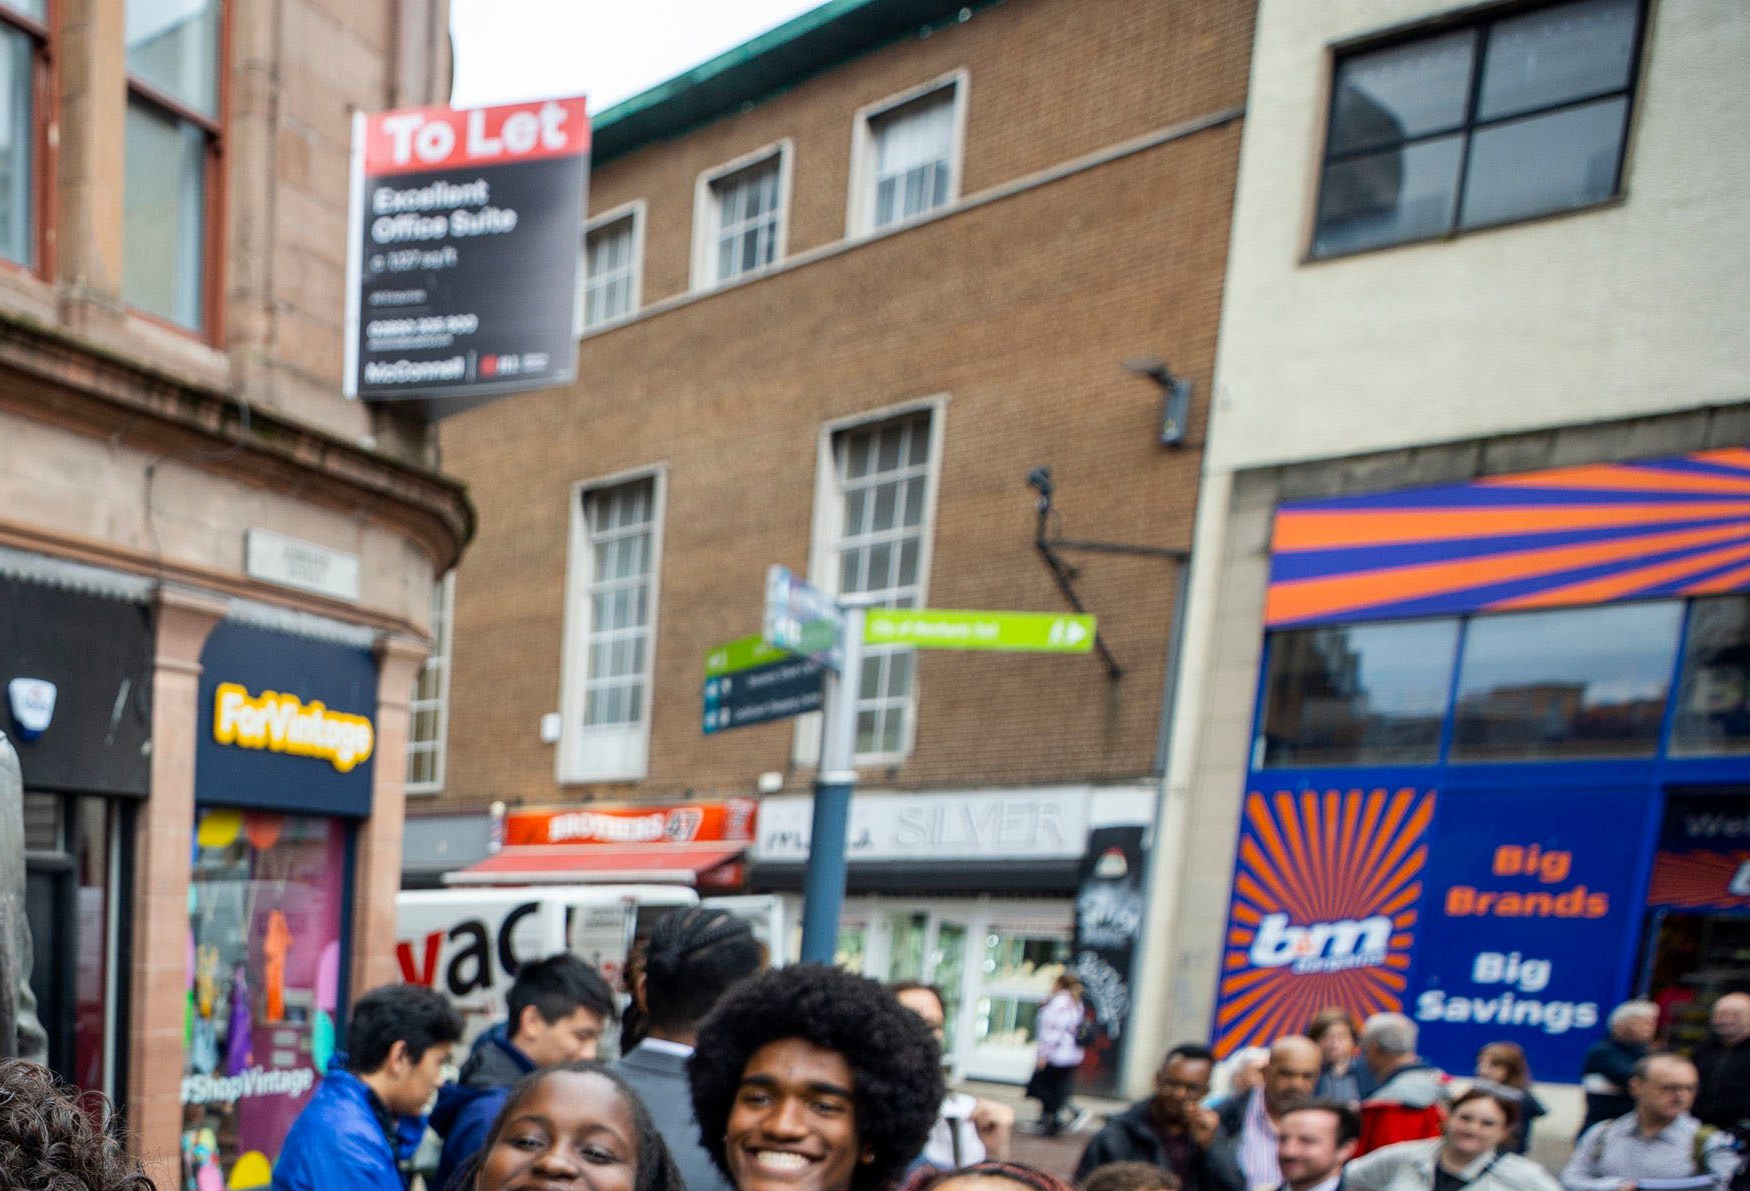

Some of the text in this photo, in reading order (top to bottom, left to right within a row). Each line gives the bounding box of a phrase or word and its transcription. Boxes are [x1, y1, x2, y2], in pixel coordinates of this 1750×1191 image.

[383, 102, 568, 164] To Let
[372, 179, 490, 215] Excellent
[370, 207, 518, 243] Office Suite
[218, 691, 371, 763] ForVintage
[548, 812, 665, 843] BROTHERS
[665, 807, 704, 842] 47
[896, 799, 1066, 848] SILVER
[1493, 844, 1572, 883] Big
[1445, 885, 1609, 919] Brands
[1472, 951, 1553, 992] Big
[1415, 990, 1599, 1034] Savings
